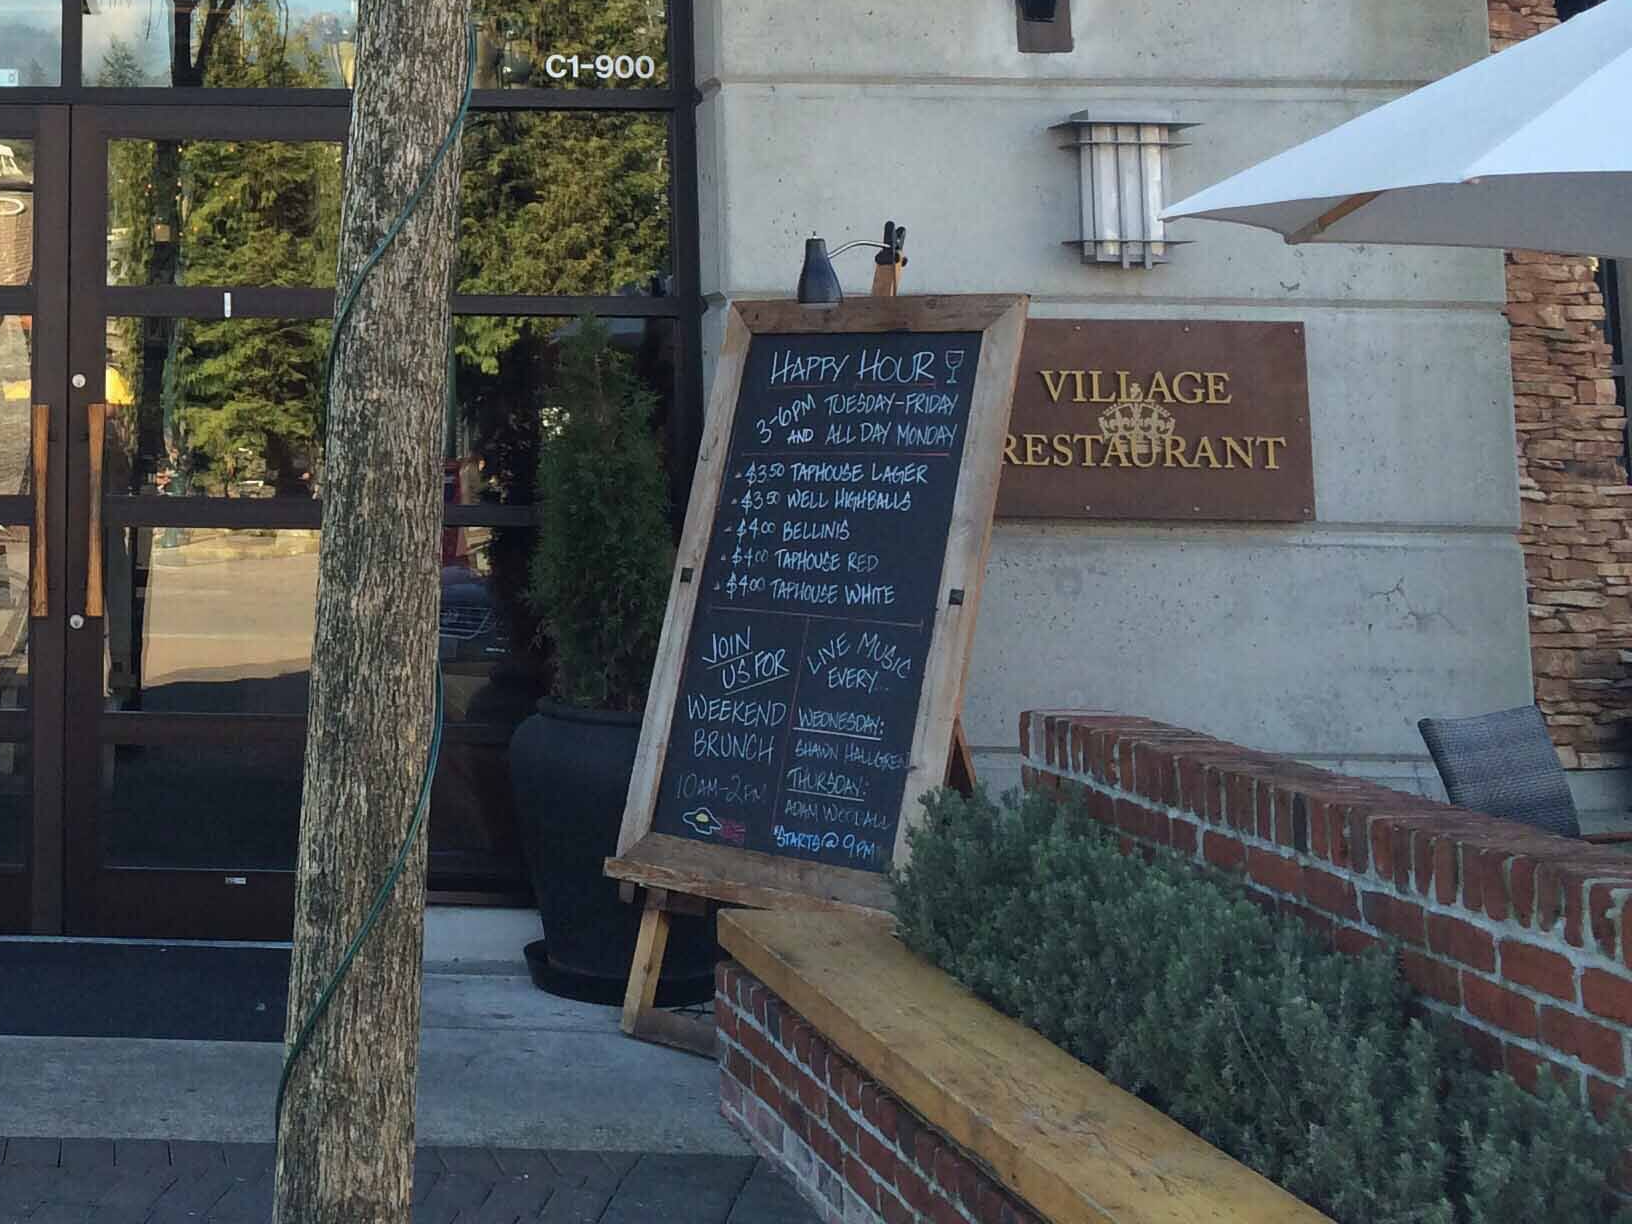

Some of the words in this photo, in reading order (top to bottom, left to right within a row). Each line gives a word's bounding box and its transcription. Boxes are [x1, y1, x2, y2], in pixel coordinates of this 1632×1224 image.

[545, 54, 655, 79] C1-900
[770, 350, 850, 385] HAPPY
[857, 349, 935, 383] HOUR
[1040, 370, 1233, 405] VILLAGE
[786, 429, 814, 445] AND
[824, 423, 856, 445] ALL
[860, 422, 892, 445] DAY
[897, 423, 958, 448] MONDAY
[790, 462, 865, 485] TAPHOUSE
[871, 463, 929, 485] LAGER
[786, 488, 829, 509] WELL
[834, 487, 912, 512] HIGHBALLS
[782, 519, 851, 541] BELLINIS
[774, 549, 841, 572] TAPHOUSE
[847, 551, 880, 572] RED
[770, 578, 839, 605] TAPHOUSE
[844, 584, 896, 605] WHITE
[701, 626, 751, 663] JOIN
[807, 632, 849, 675] LIVE
[856, 632, 912, 679] MUSIC
[722, 658, 751, 689] US
[754, 649, 790, 678] FOR
[687, 693, 787, 727] WEEKEND
[694, 728, 775, 766] BRUNCH
